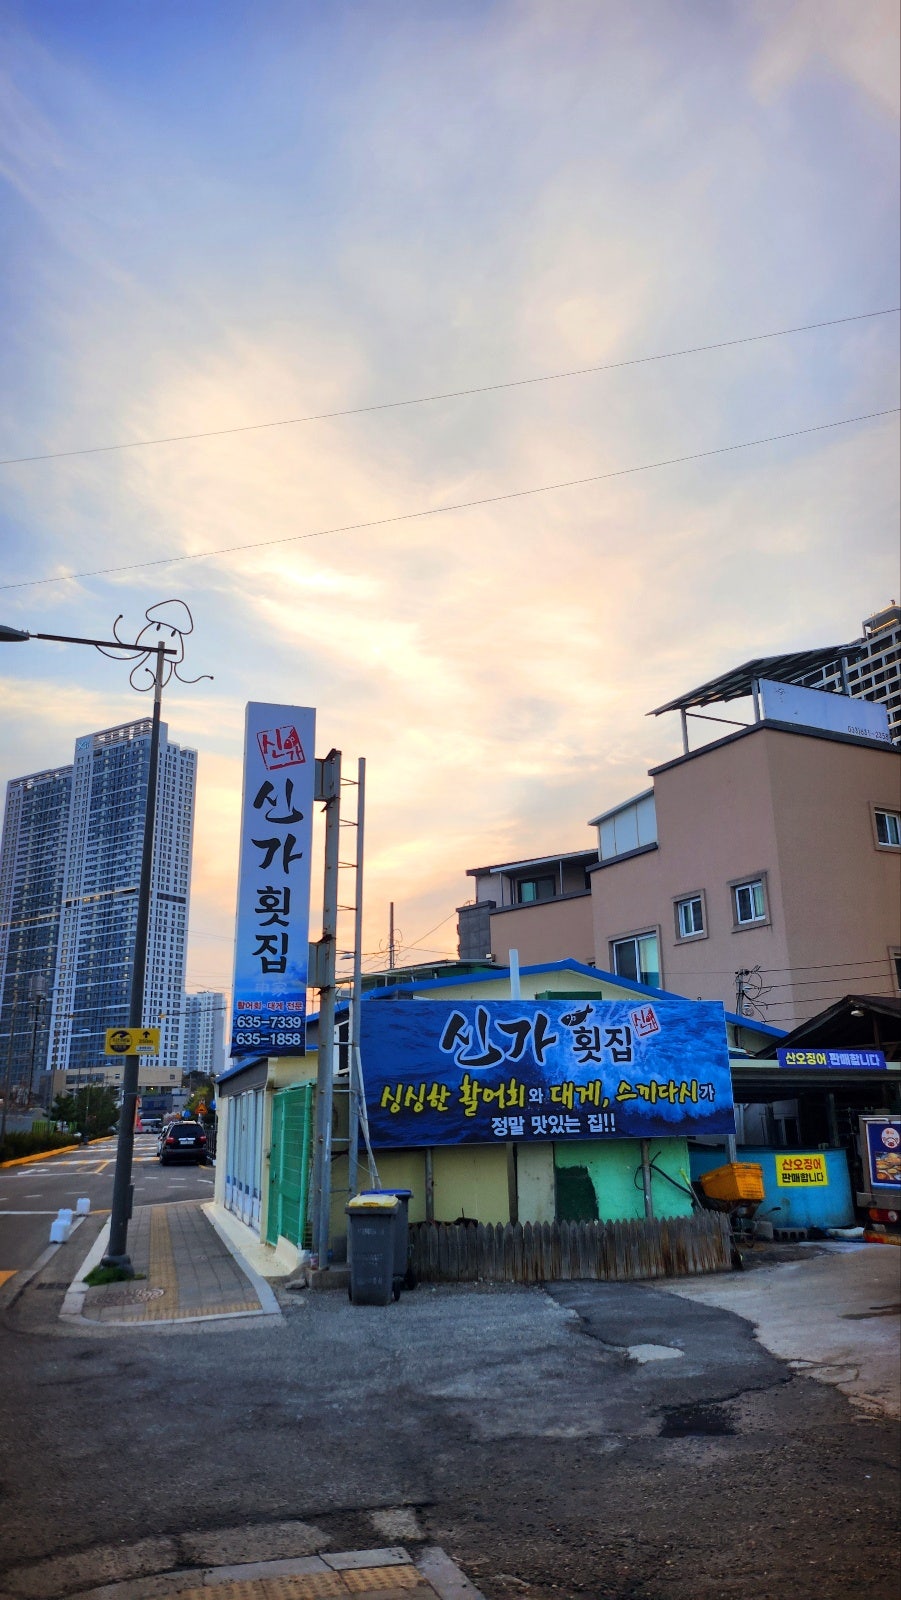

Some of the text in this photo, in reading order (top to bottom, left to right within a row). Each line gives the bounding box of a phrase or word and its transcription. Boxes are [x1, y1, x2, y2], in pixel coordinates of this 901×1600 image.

[236, 1015, 302, 1029] 635-7339
[236, 1032, 301, 1046] 635-1858
[441, 1006, 632, 1067] 신가 횟집
[785, 1051, 881, 1067] 산오징어 판매합니다
[380, 1083, 451, 1113] 싱싱한
[549, 1080, 610, 1110] 대게,
[491, 1112, 616, 1137] 정말 맛있는 집!!
[782, 1157, 822, 1171] 산오징어
[781, 1171, 824, 1184] 판매합니다
